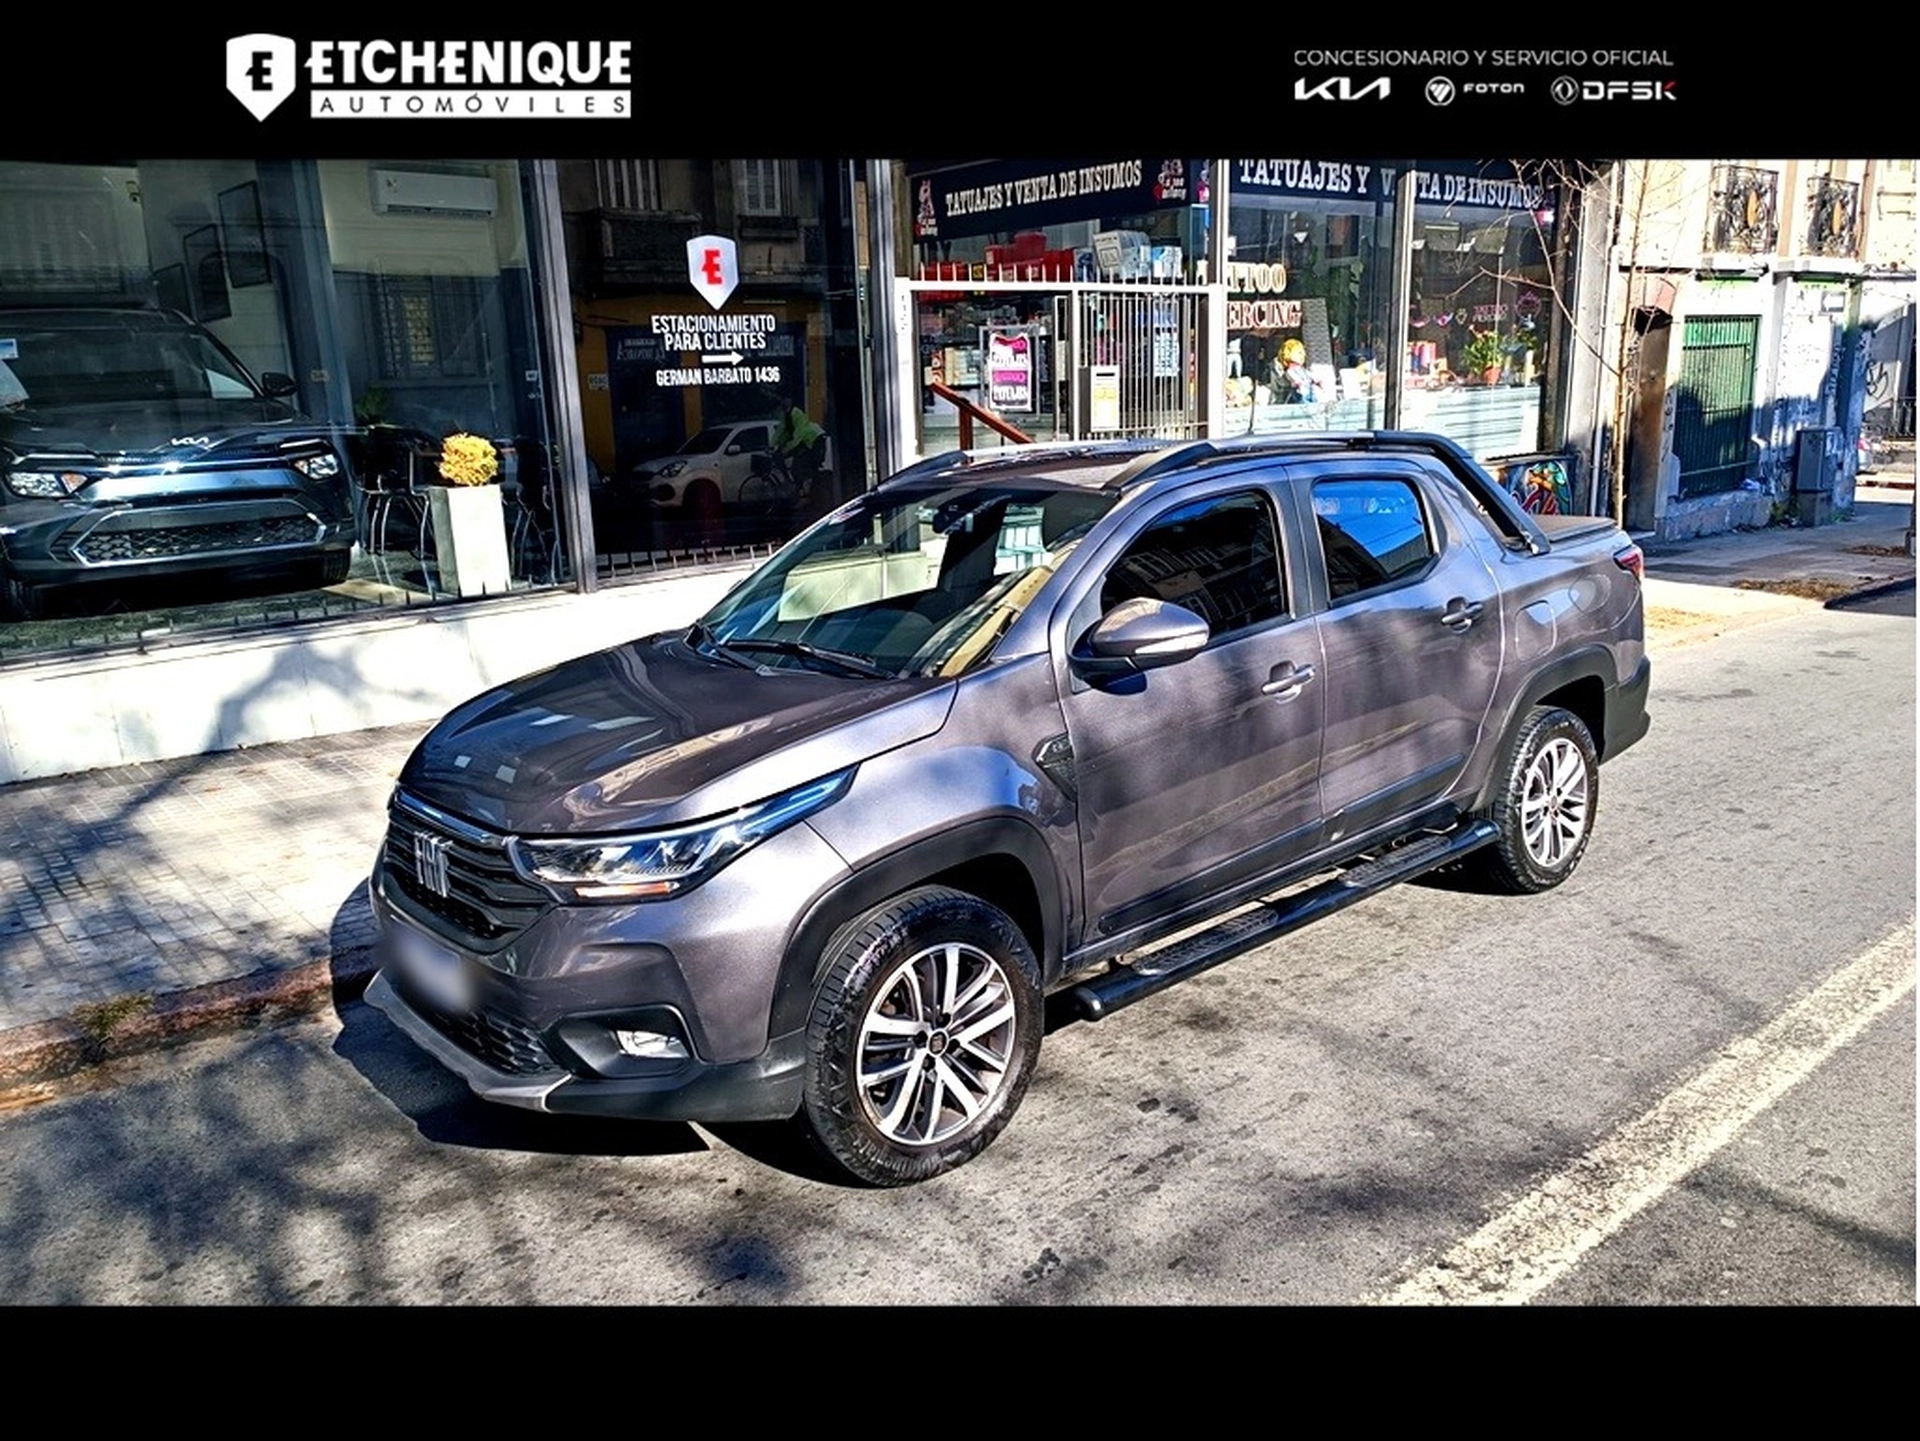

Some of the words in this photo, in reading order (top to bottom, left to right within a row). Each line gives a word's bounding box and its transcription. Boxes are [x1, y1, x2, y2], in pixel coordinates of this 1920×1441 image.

[945, 178, 1003, 217] TATUAJES
[1004, 177, 1015, 207] Y
[1014, 171, 1057, 205] VENTA
[1059, 169, 1078, 196] DE
[1079, 160, 1142, 195] INSUMOS
[1240, 160, 1352, 193] TATUAJES
[1355, 166, 1370, 194] Y
[1381, 168, 1441, 200] VTA
[1443, 175, 1466, 201] DE
[1467, 178, 1541, 209] INSUMOS
[1228, 262, 1287, 293] TTOO
[651, 314, 776, 334] ESTACIONAMIENTO
[1228, 300, 1303, 329] ERCING
[664, 333, 702, 351] PARA
[704, 331, 766, 350] CLIENTES
[656, 368, 702, 387] GERMAN
[704, 367, 752, 386] BARBATO
[755, 366, 780, 383] 1436
